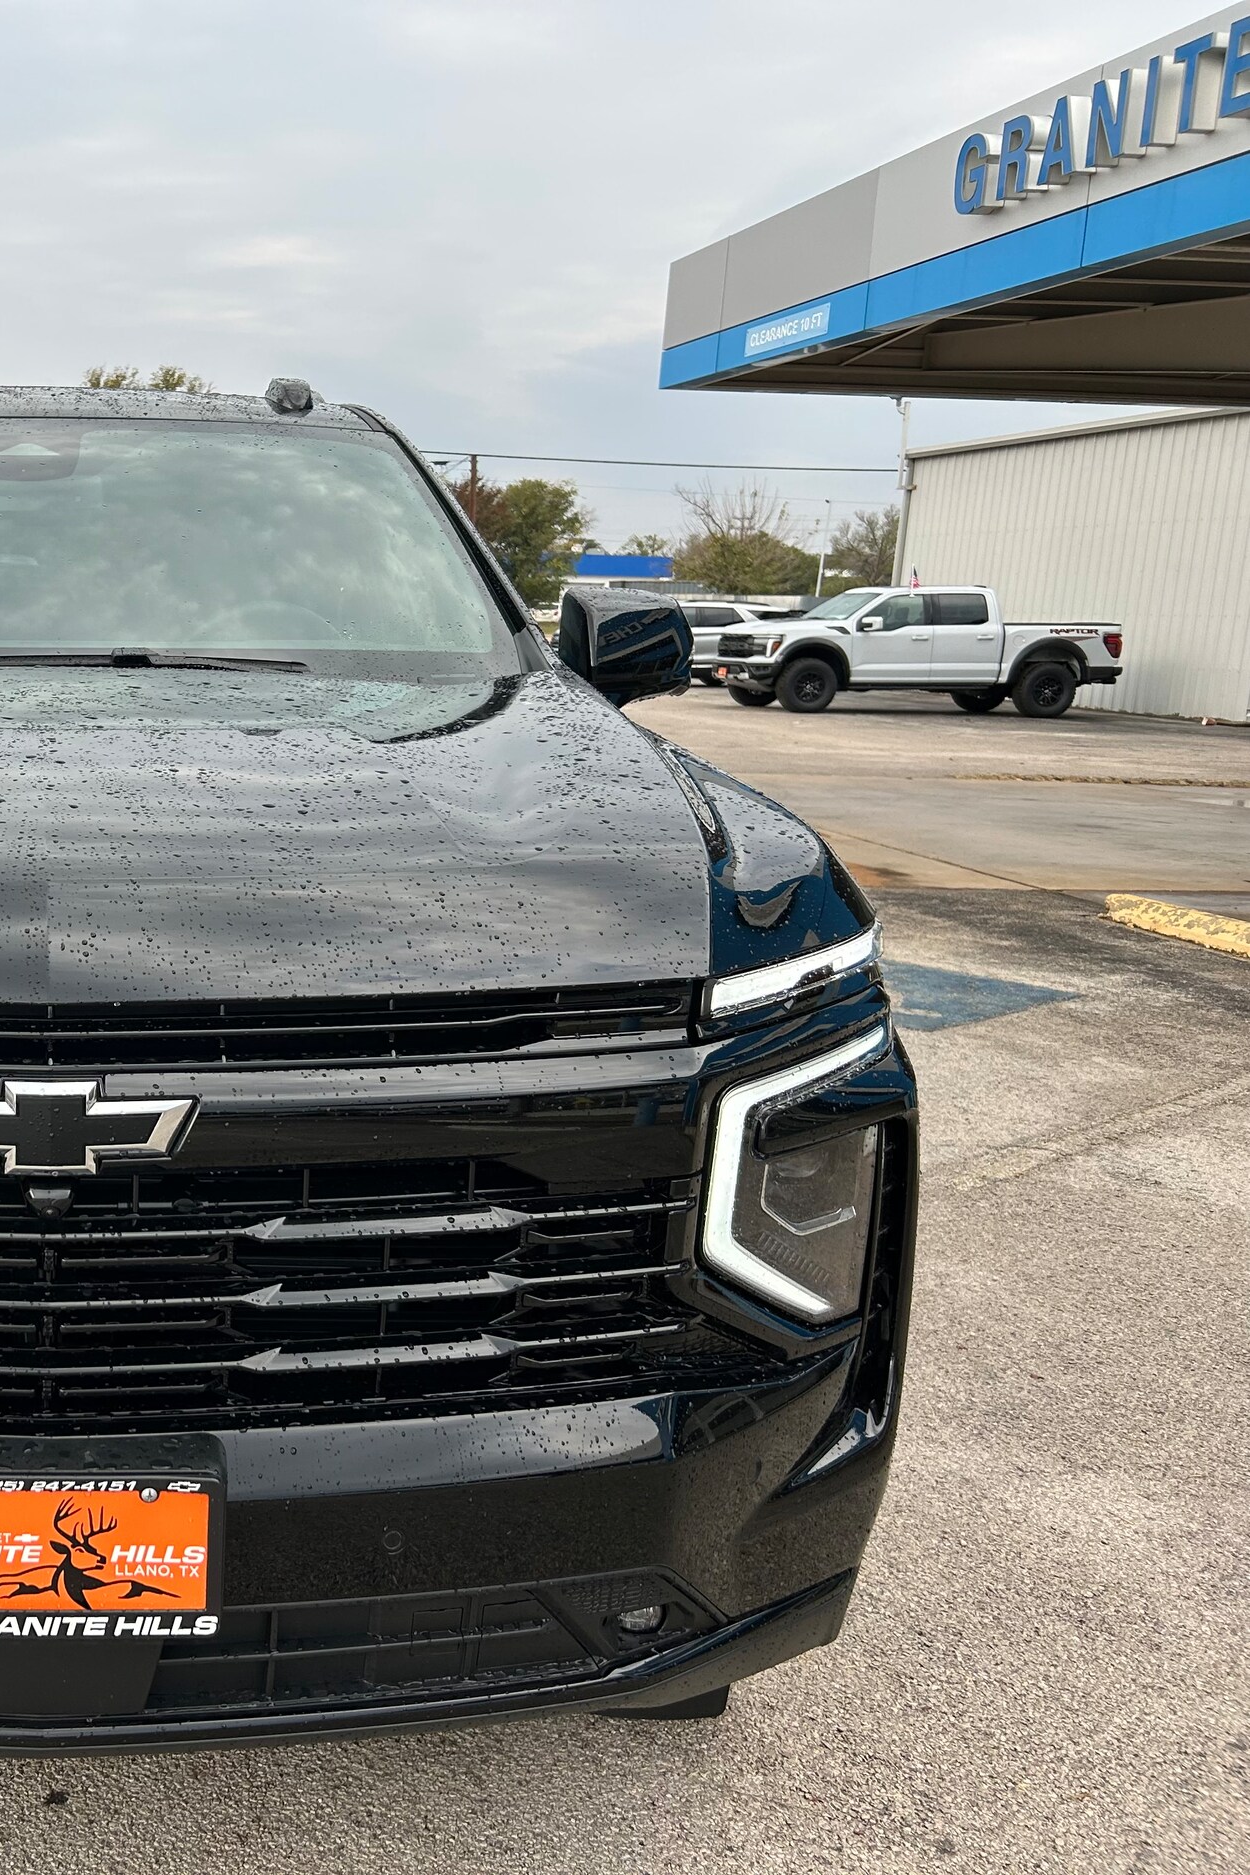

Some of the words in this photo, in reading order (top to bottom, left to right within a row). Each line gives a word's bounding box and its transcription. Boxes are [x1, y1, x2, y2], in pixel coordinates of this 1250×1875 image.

[953, 15, 1250, 216] GRANITE
[749, 319, 799, 347] CLEARANCE
[800, 317, 810, 332] 10
[810, 312, 823, 329] FT
[1049, 628, 1100, 637] RAPTOR
[30, 1480, 137, 1492] 247-4151
[110, 1544, 207, 1564] HILLS
[115, 1564, 174, 1578] LLANO,
[179, 1565, 200, 1577] TX
[113, 1615, 219, 1637] HILLS
